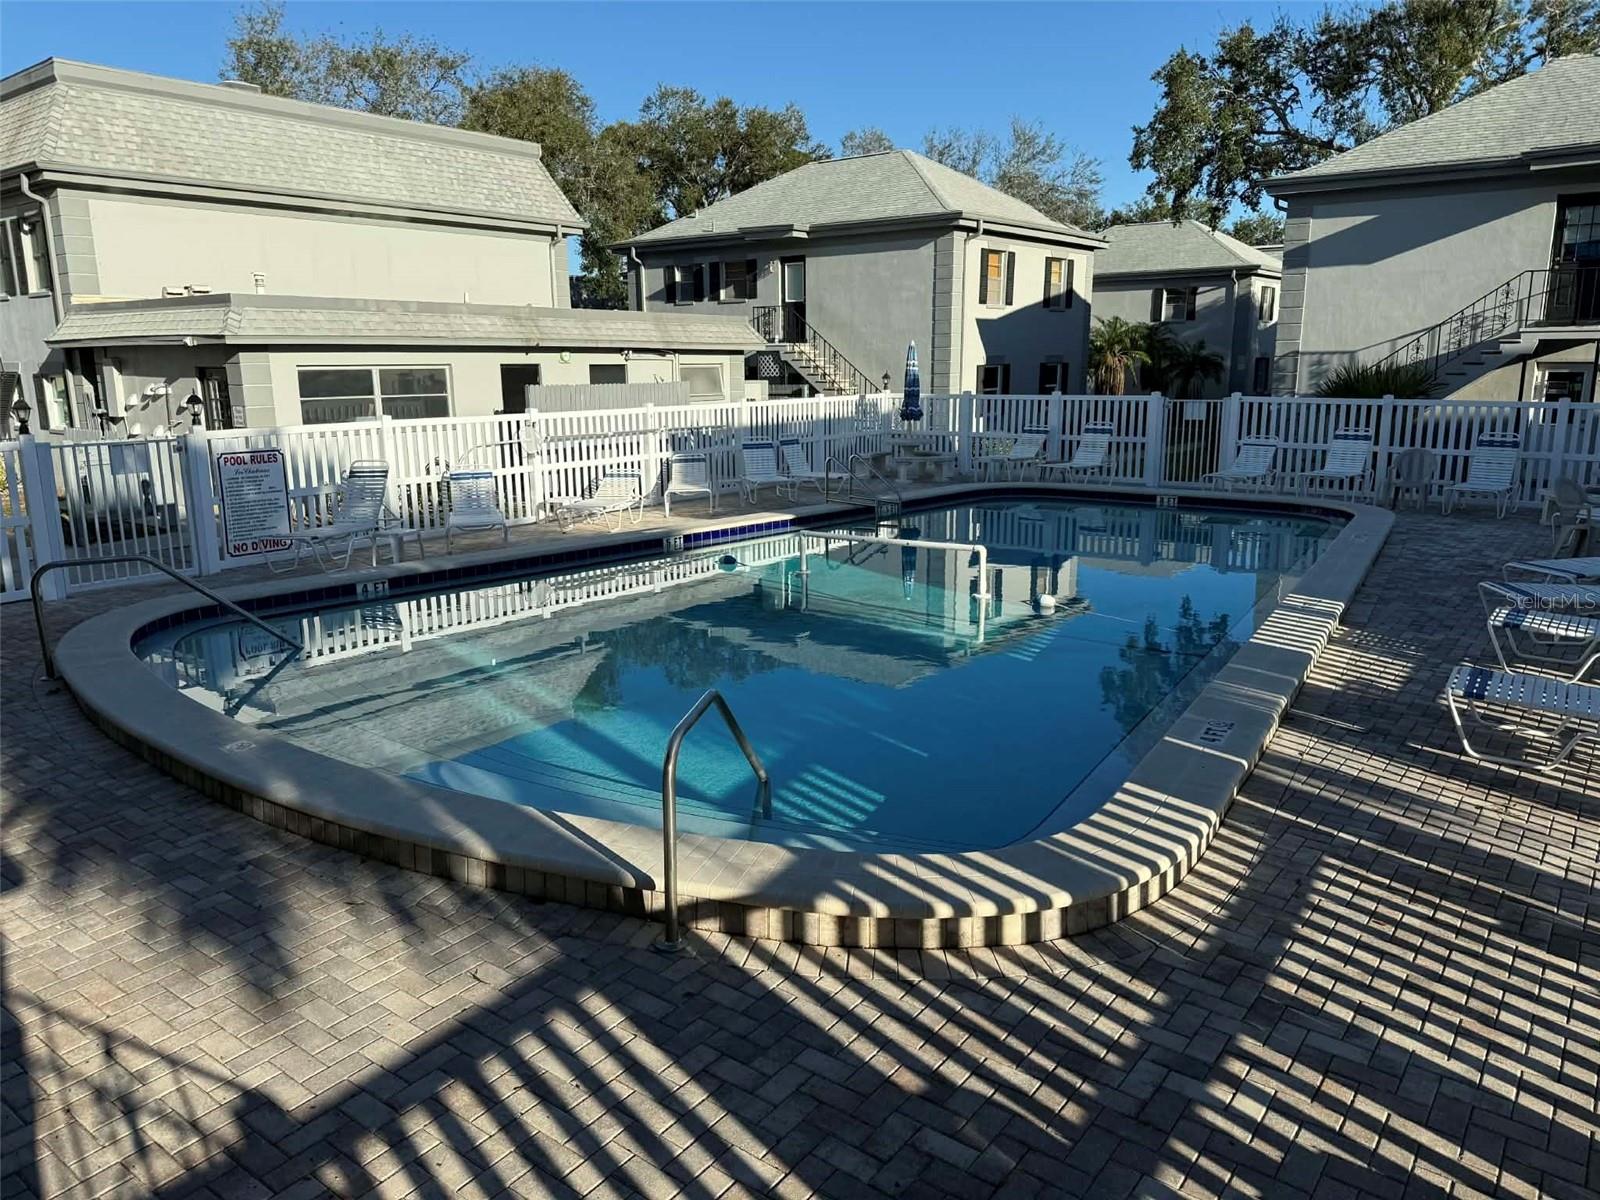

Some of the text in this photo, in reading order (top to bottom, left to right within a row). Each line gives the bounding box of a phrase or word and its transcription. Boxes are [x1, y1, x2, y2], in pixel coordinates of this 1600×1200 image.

[224, 453, 278, 467] POOL RULES
[233, 543, 248, 553] NO
[361, 580, 386, 593] 4 FT
